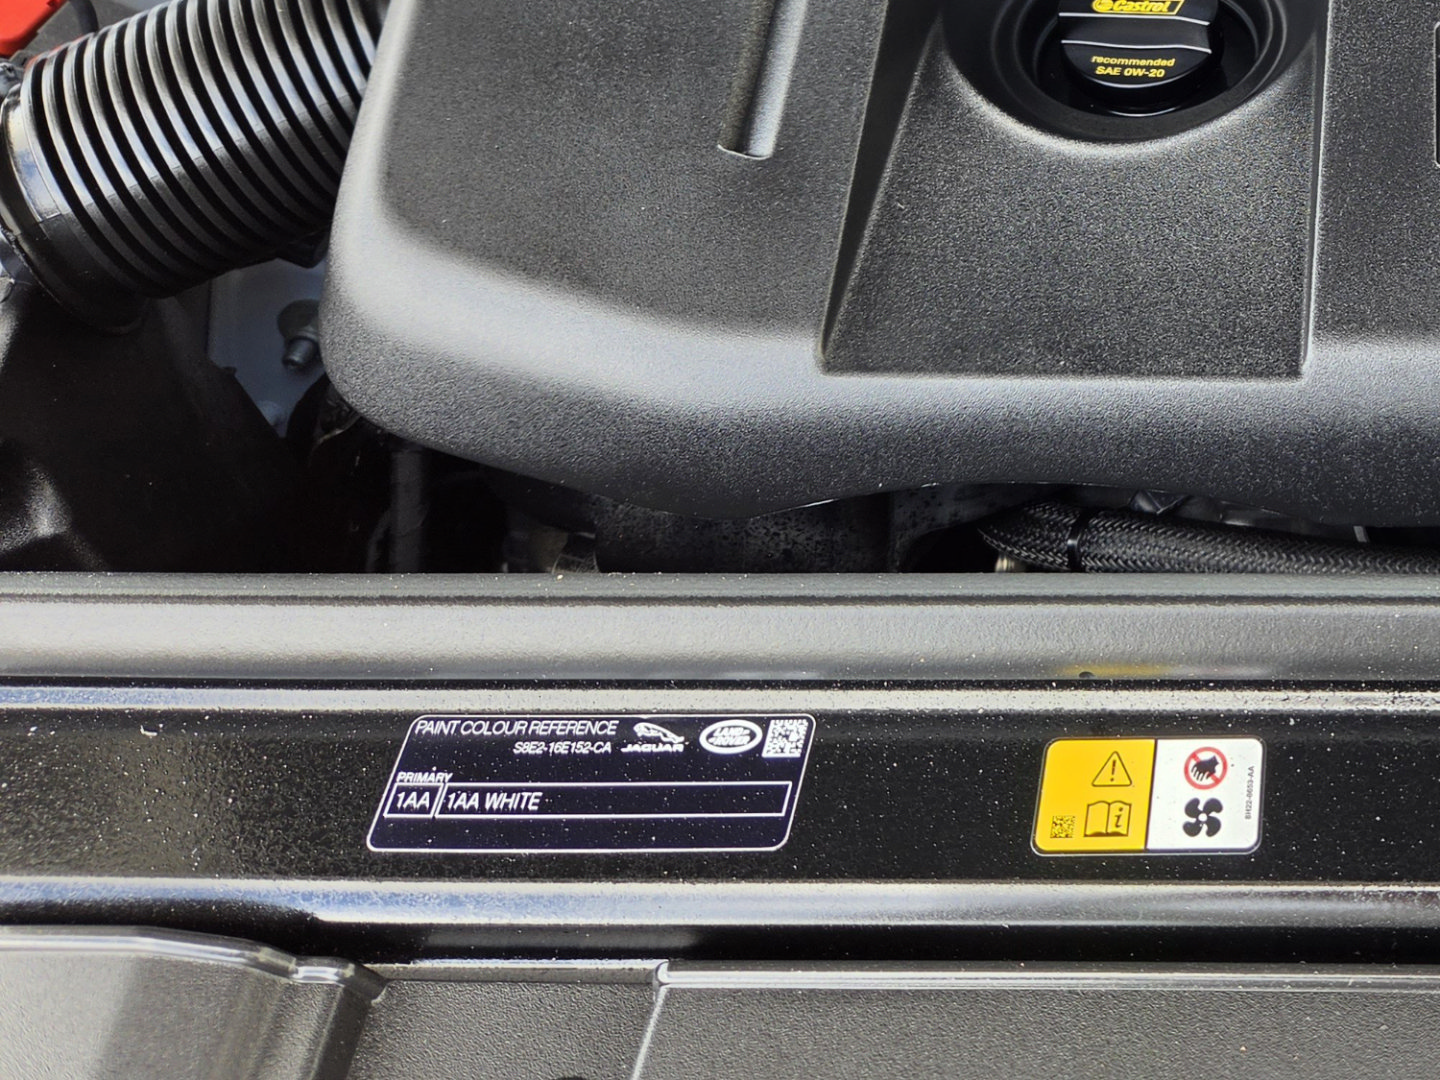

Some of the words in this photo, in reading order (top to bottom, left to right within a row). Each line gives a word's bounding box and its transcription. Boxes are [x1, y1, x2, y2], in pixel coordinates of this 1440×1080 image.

[1112, 0, 1171, 12] Castrol
[1091, 56, 1175, 66] recommended
[1095, 66, 1121, 75] SAE
[1123, 68, 1165, 77] 0W-20
[414, 720, 460, 735] PAINT
[460, 720, 528, 736] COLOUR
[528, 720, 620, 736] REFERENCE
[513, 741, 612, 754] S8E2-16E152-CA
[620, 743, 685, 753] JAGUAR
[396, 772, 453, 783] PRIMARY
[396, 791, 431, 809] 1AA
[447, 792, 480, 810] 1AA
[484, 792, 543, 811] WHITE
